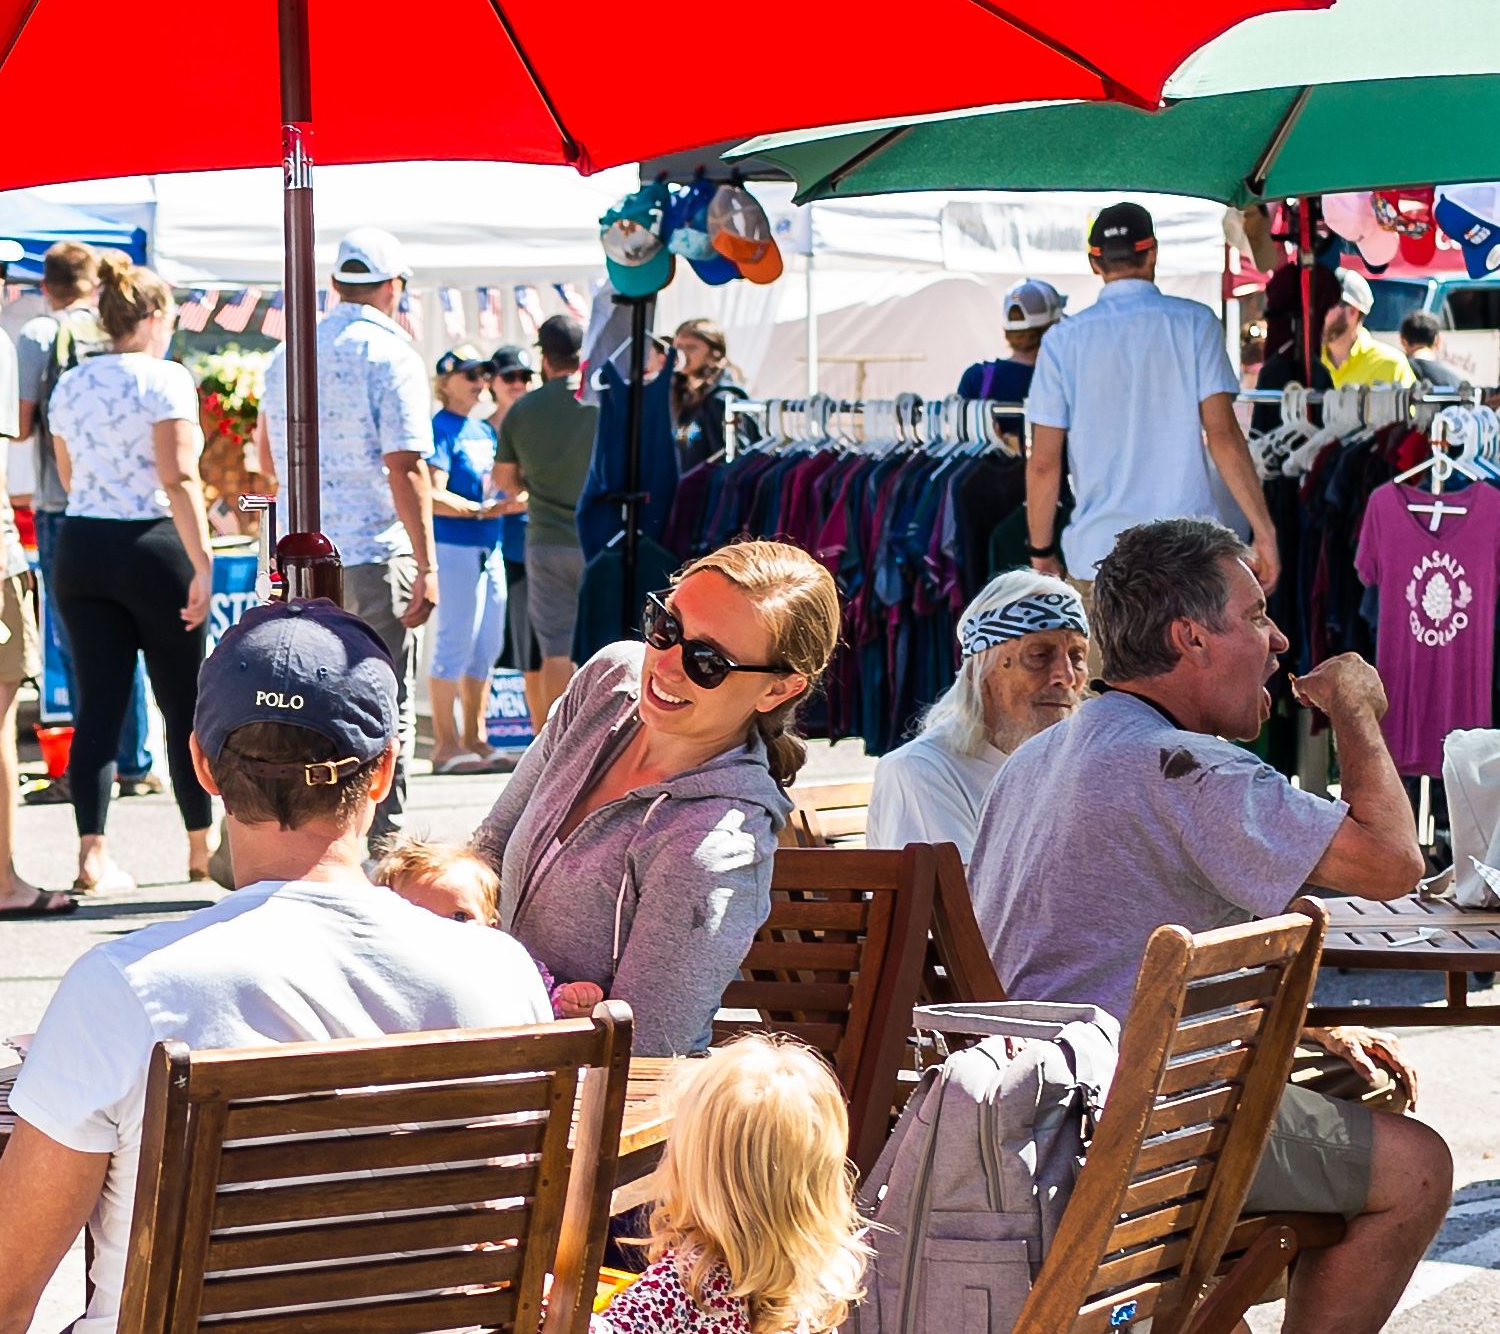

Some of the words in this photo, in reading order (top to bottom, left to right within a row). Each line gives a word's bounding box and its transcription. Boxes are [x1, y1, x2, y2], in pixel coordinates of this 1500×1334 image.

[1412, 549, 1466, 580] BASALT
[1409, 610, 1469, 647] COLORDO
[255, 690, 304, 710] POLO
